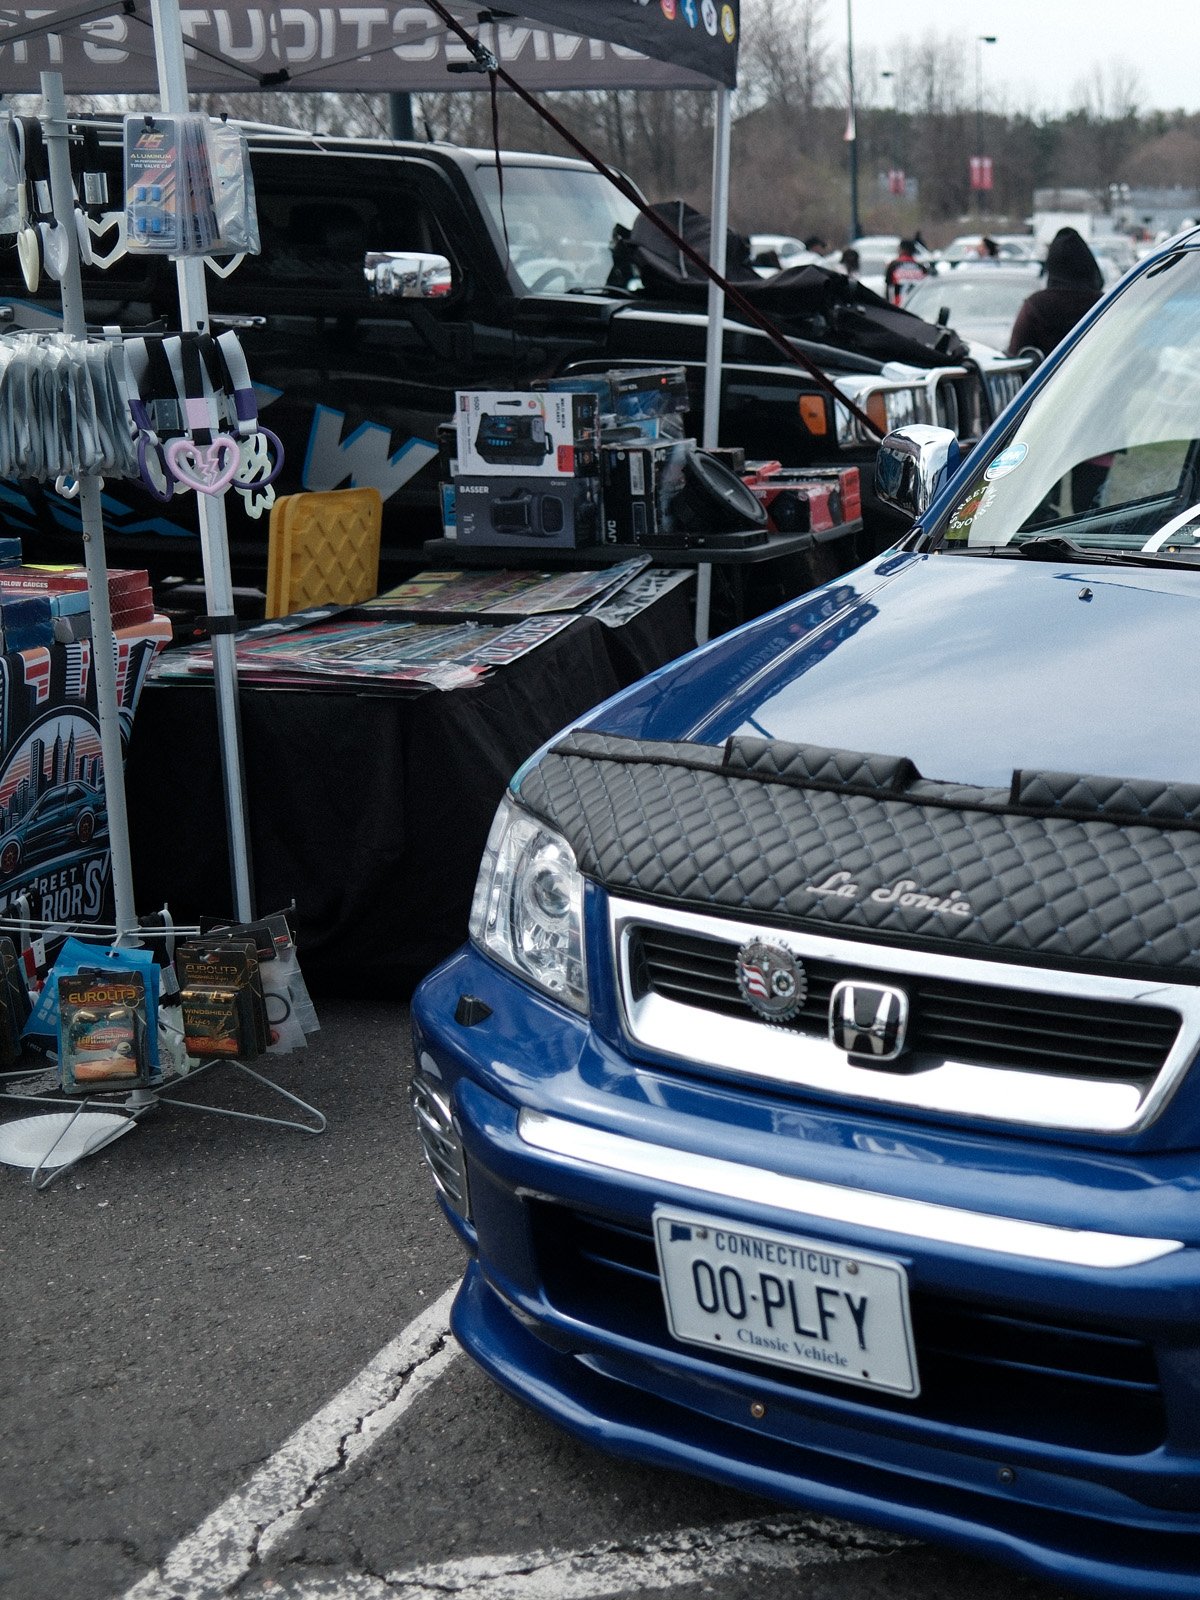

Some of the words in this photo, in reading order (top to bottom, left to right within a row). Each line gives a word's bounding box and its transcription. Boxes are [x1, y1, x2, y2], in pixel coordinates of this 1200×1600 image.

[459, 485, 489, 494] BASSER
[607, 519, 617, 543] JVC
[806, 871, 858, 898] La
[871, 880, 971, 916] Sonic
[184, 1008, 233, 1016] WINDSHIELD
[715, 1233, 842, 1278] CONNECTICUT
[737, 1328, 789, 1353] Classic
[793, 1341, 848, 1367] Vehicle
